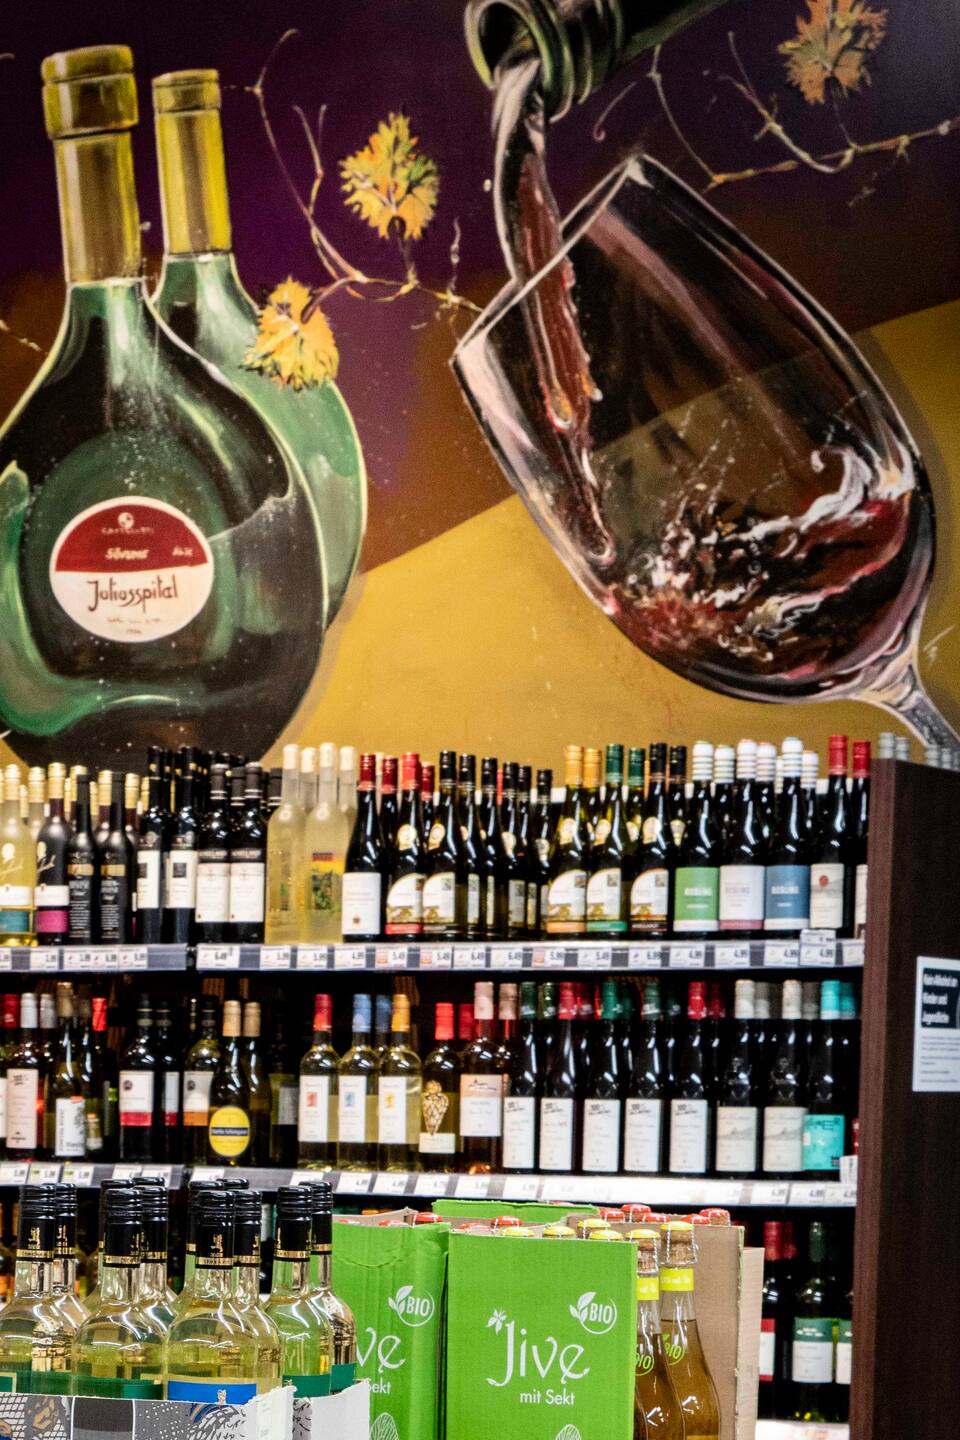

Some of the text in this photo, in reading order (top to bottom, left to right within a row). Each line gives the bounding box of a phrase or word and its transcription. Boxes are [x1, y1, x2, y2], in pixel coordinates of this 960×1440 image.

[408, 1299, 430, 1318] BIO
[590, 1304, 613, 1324] BIO
[485, 1307, 590, 1387] Jive
[520, 1389, 575, 1406] mit Sekt
